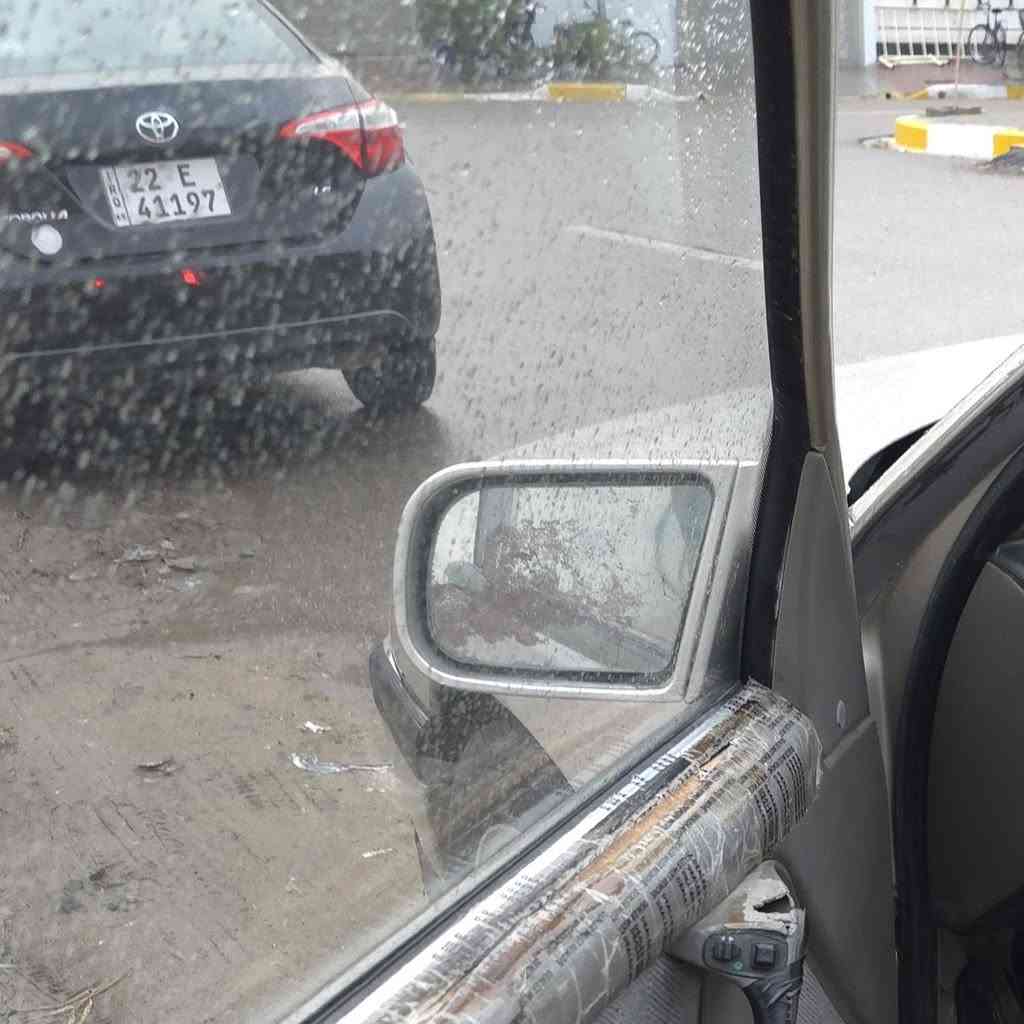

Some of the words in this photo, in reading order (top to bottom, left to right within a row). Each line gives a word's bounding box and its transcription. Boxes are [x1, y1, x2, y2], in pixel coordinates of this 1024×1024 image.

[128, 167, 162, 193] 22
[177, 164, 196, 187] E
[138, 189, 216, 219] 41197
